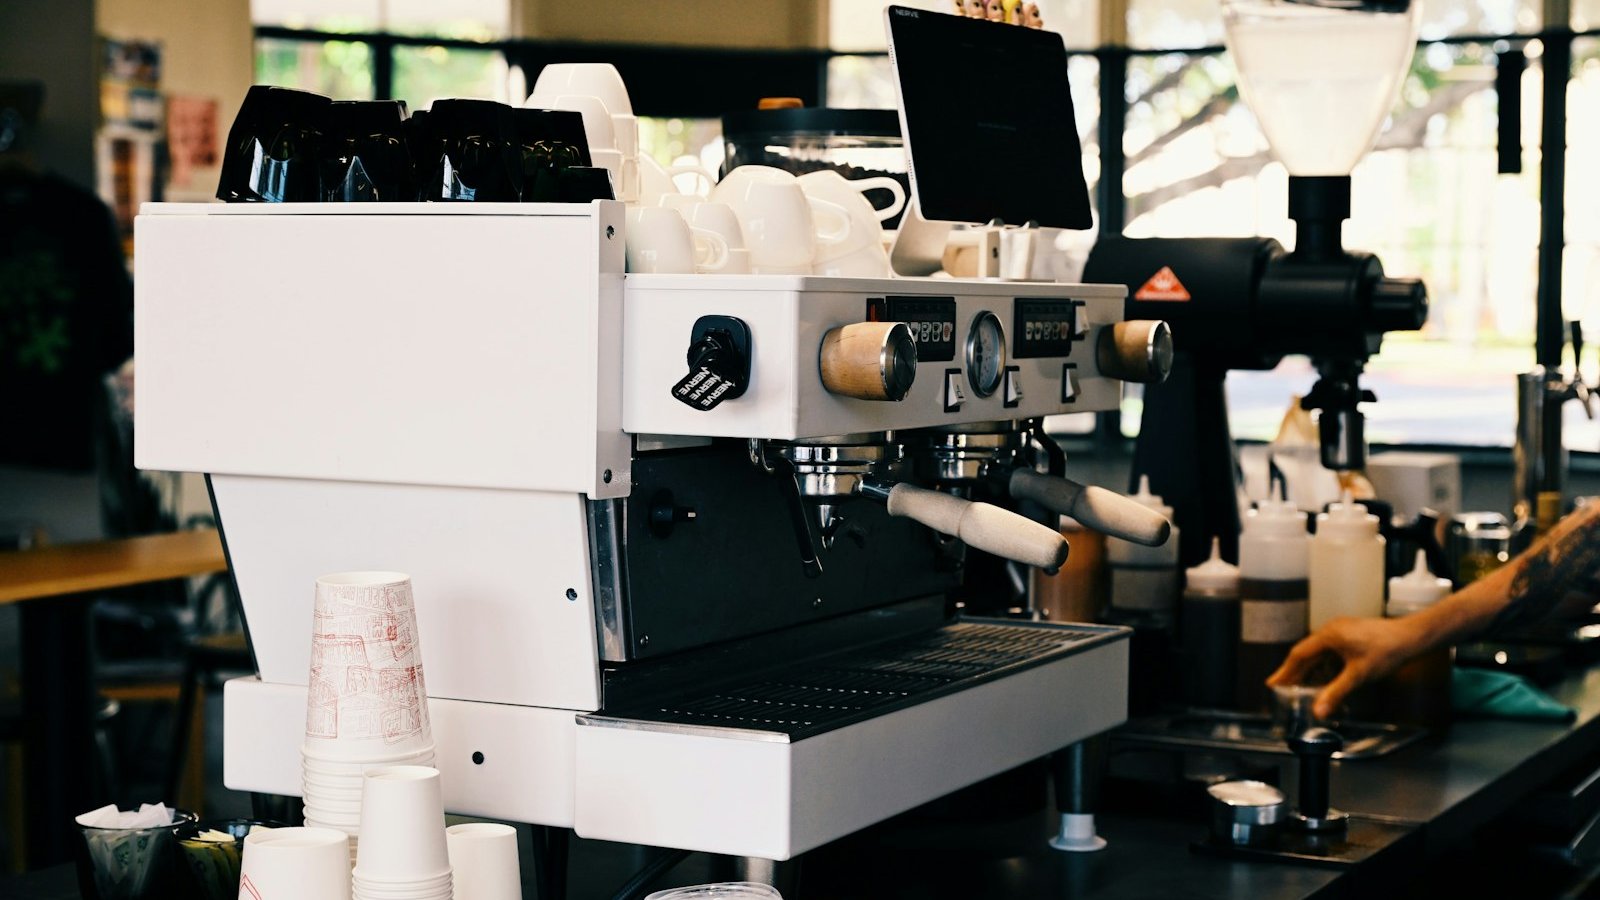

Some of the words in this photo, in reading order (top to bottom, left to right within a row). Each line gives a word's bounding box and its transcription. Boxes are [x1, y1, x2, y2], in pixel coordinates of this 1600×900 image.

[895, 9, 919, 18] NERVE
[678, 367, 710, 395] NERVE
[689, 371, 721, 400] NERVE
[701, 380, 732, 406] NERVE
